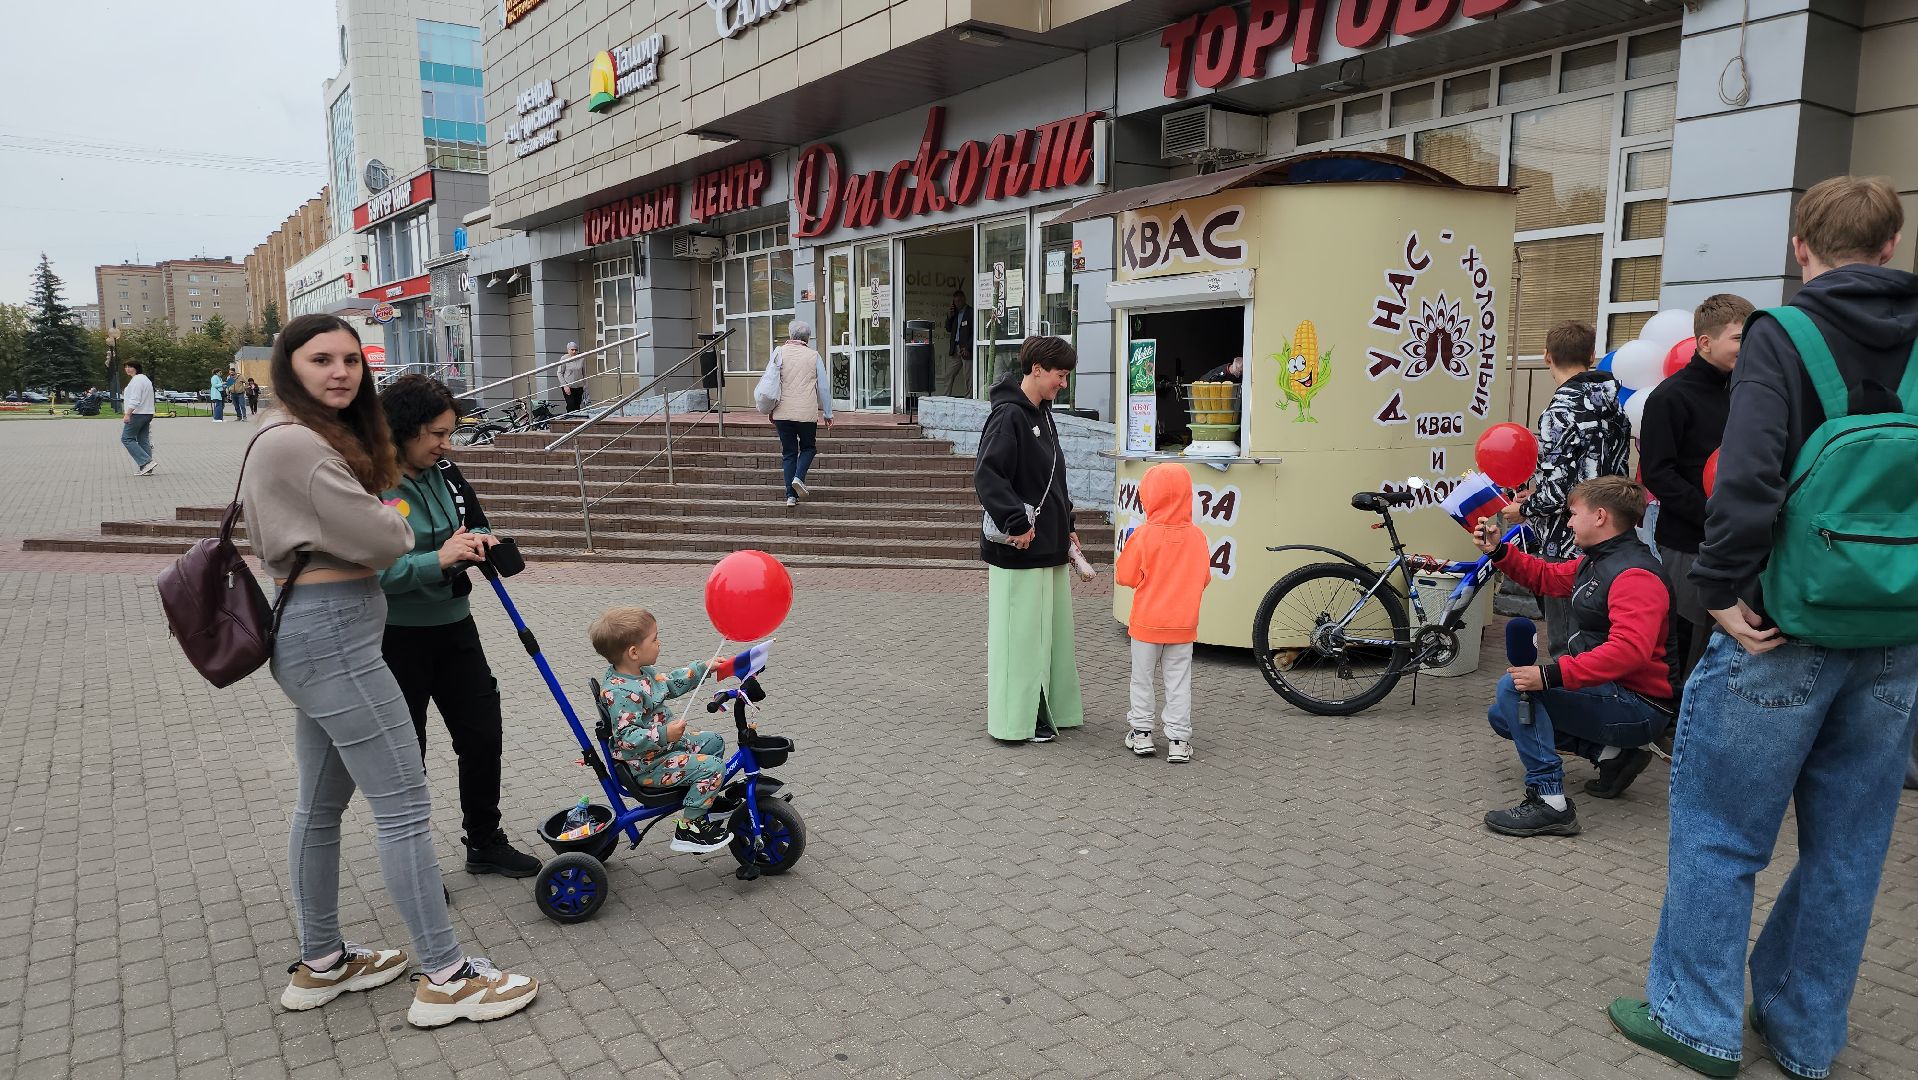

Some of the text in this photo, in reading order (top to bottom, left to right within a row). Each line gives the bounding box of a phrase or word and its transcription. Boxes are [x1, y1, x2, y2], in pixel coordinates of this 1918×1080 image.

[613, 33, 663, 76] Ташир
[1160, 0, 1540, 98] ТОРГО
[516, 79, 554, 114] АРЕНДА
[583, 158, 768, 246] ТОРГОВЫЙ ЦЕНТР
[792, 106, 1107, 237] Дисконт
[1120, 210, 1242, 271] КВАС
[935, 272, 966, 291] Day
[1461, 248, 1497, 417] ХОЛОДНЫЙ
